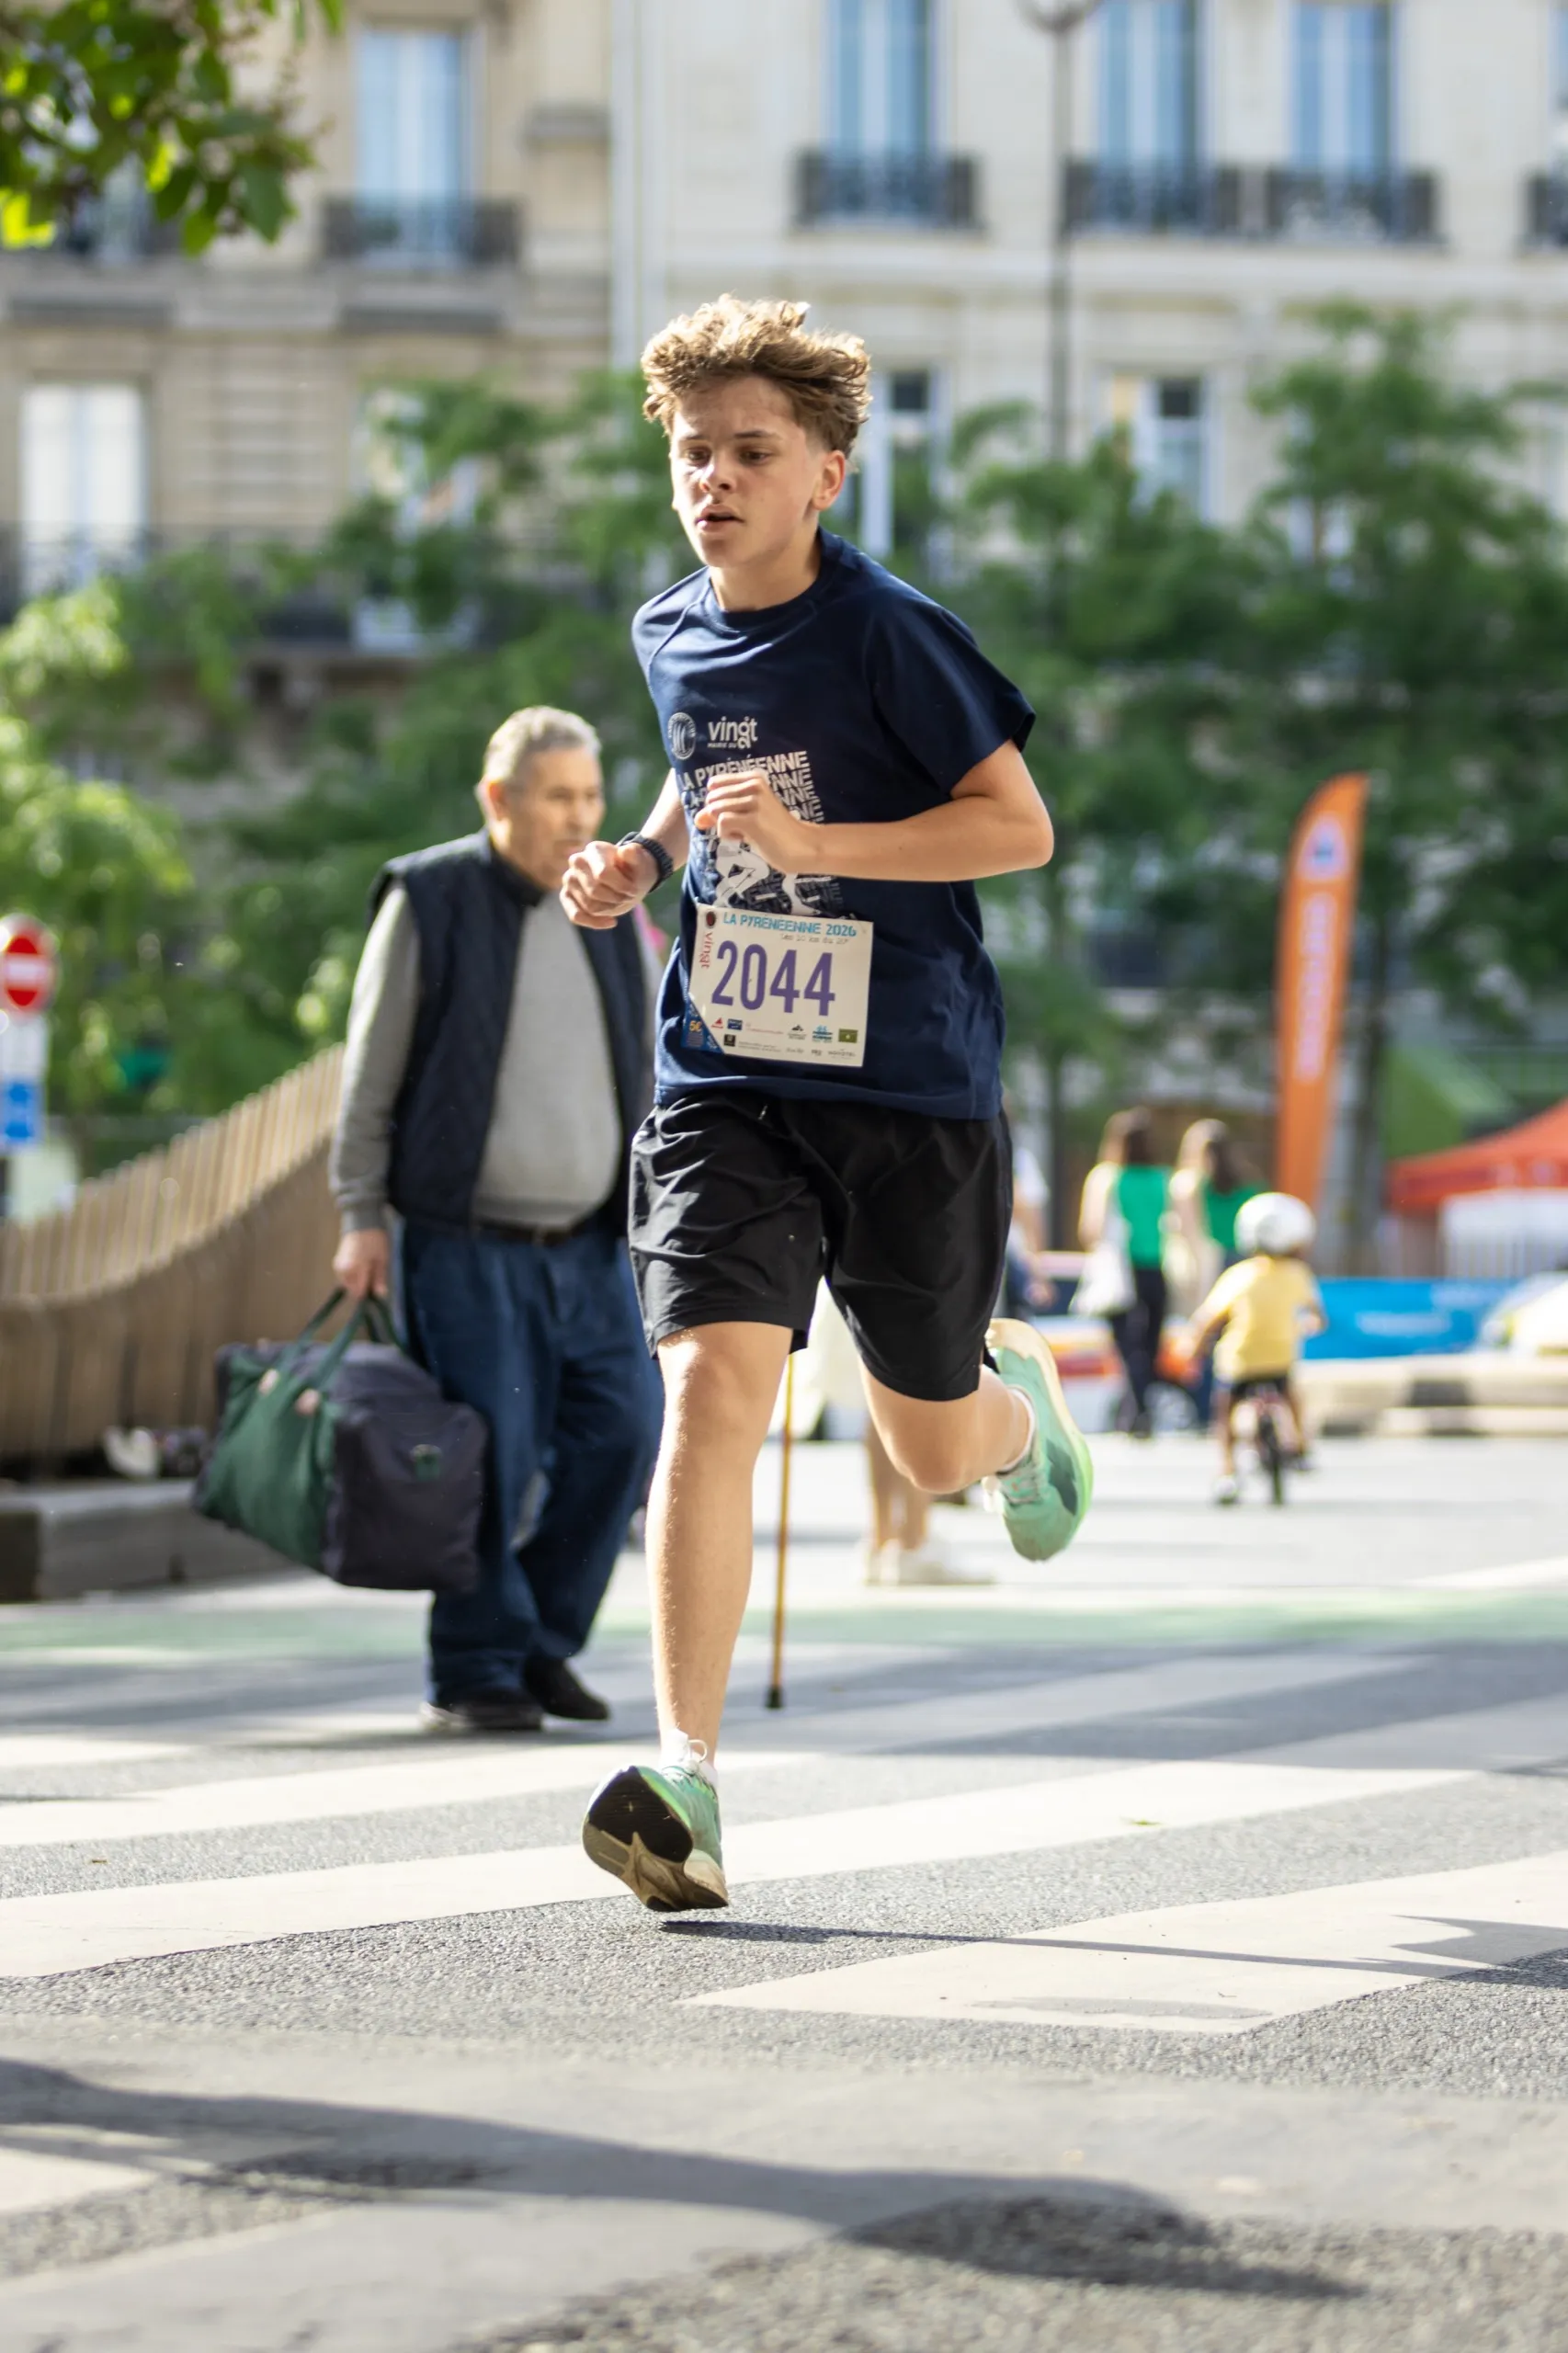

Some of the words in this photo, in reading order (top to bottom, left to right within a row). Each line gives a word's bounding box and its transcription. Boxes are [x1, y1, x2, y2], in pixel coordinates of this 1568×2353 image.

[708, 716, 758, 749] vingt
[723, 912, 737, 926] LA
[825, 924, 857, 937] 2026
[711, 940, 835, 1017] 2044
